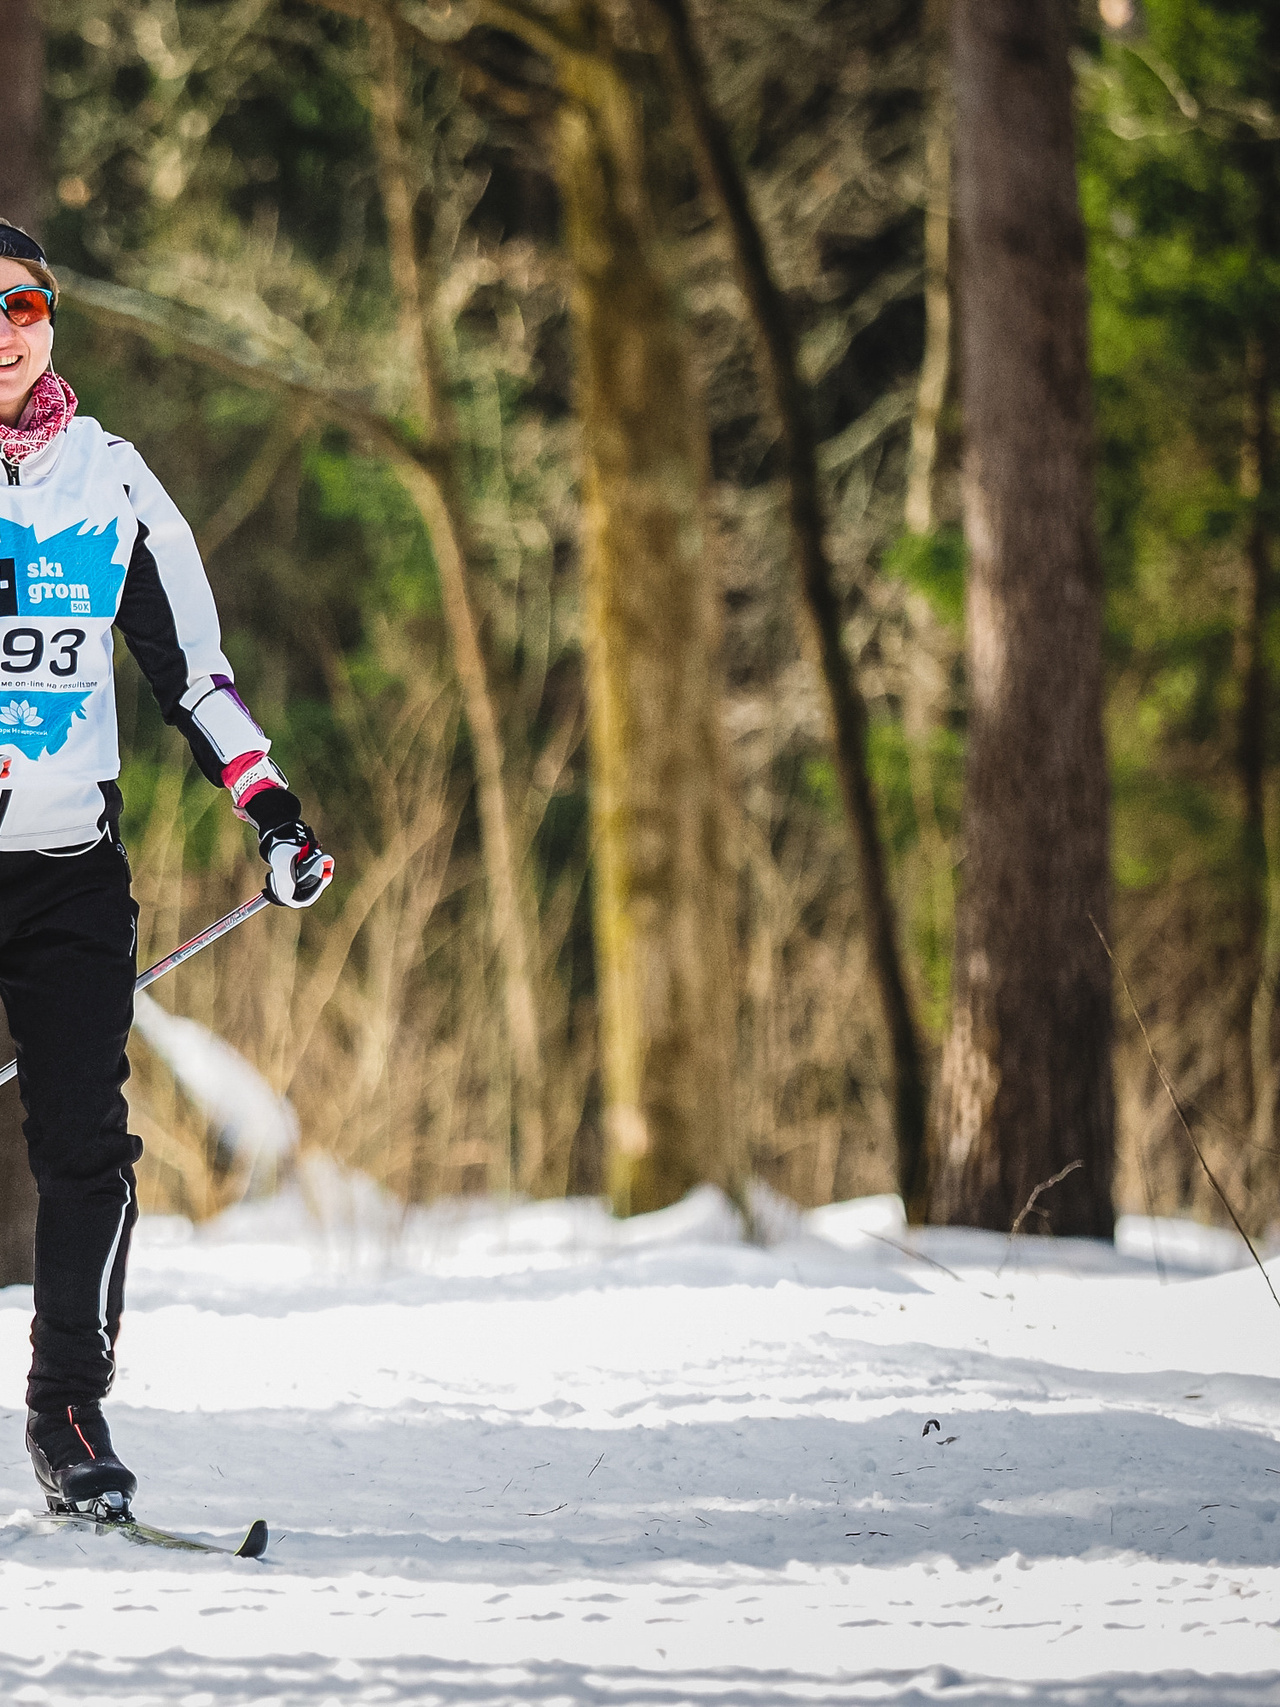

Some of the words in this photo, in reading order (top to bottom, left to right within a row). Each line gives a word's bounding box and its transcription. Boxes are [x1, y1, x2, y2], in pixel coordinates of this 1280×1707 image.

[27, 556, 64, 578] ski
[28, 582, 90, 604] grom
[72, 602, 90, 612] 50K
[15, 680, 45, 688] on-line
[46, 682, 57, 690] на
